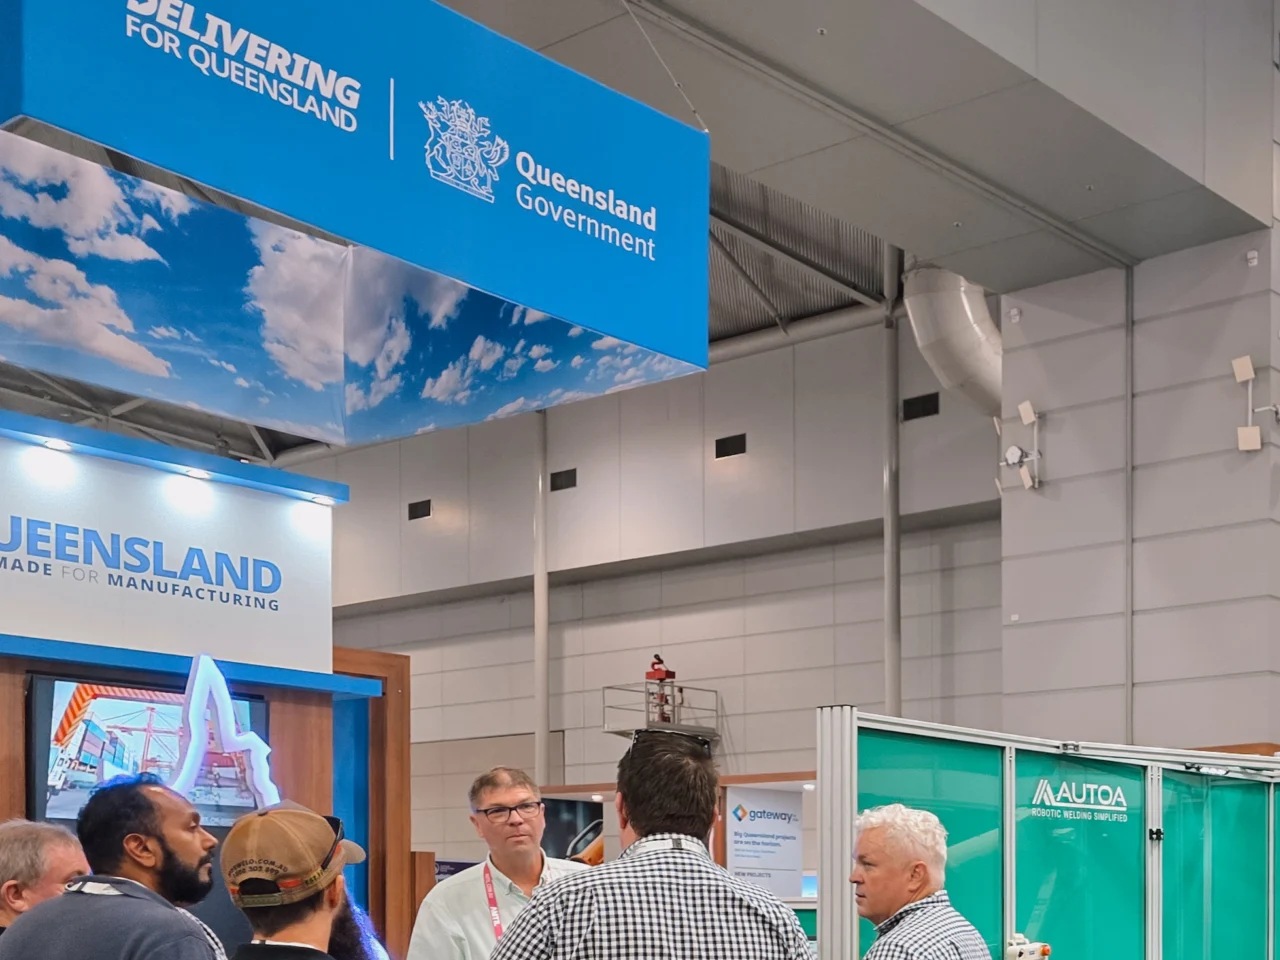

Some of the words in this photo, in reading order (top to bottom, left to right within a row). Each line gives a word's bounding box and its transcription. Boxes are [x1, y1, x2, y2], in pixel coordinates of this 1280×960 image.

[126, 0, 361, 109] DELIVERING
[126, 14, 182, 59] FOR
[188, 44, 357, 132] QUEENSLAND
[516, 151, 656, 231] Queensland
[516, 183, 656, 261] Government
[0, 515, 281, 594] UEENSLAND
[61, 565, 99, 584] FOR
[108, 573, 279, 611] MANUFACTURING
[749, 809, 792, 824] gateway
[1032, 808, 1061, 818] ROBOTIC
[1063, 810, 1092, 820] WELDING
[1093, 812, 1128, 822] SIMPLIFIED
